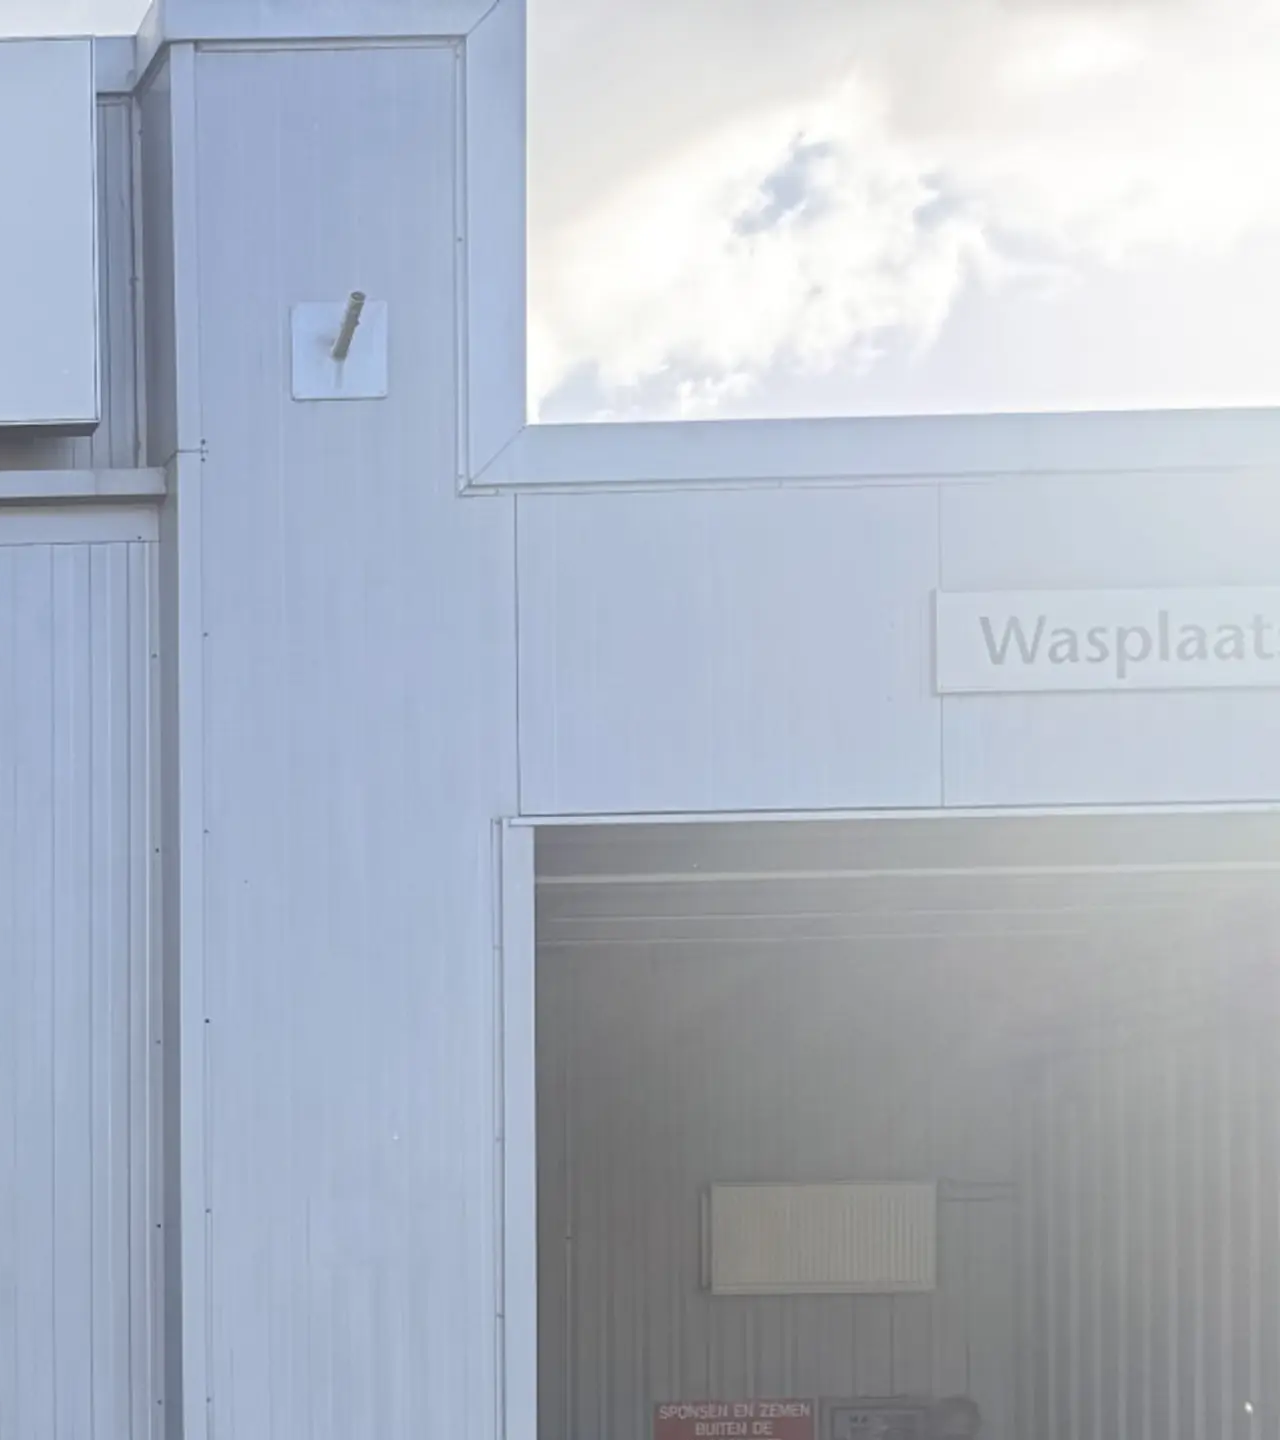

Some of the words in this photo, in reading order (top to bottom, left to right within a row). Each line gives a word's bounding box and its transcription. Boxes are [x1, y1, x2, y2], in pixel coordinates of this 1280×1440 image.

[979, 609, 1280, 679] Wasplaat
[695, 1421, 747, 1436] BUITEN
[752, 1421, 773, 1435] DE
